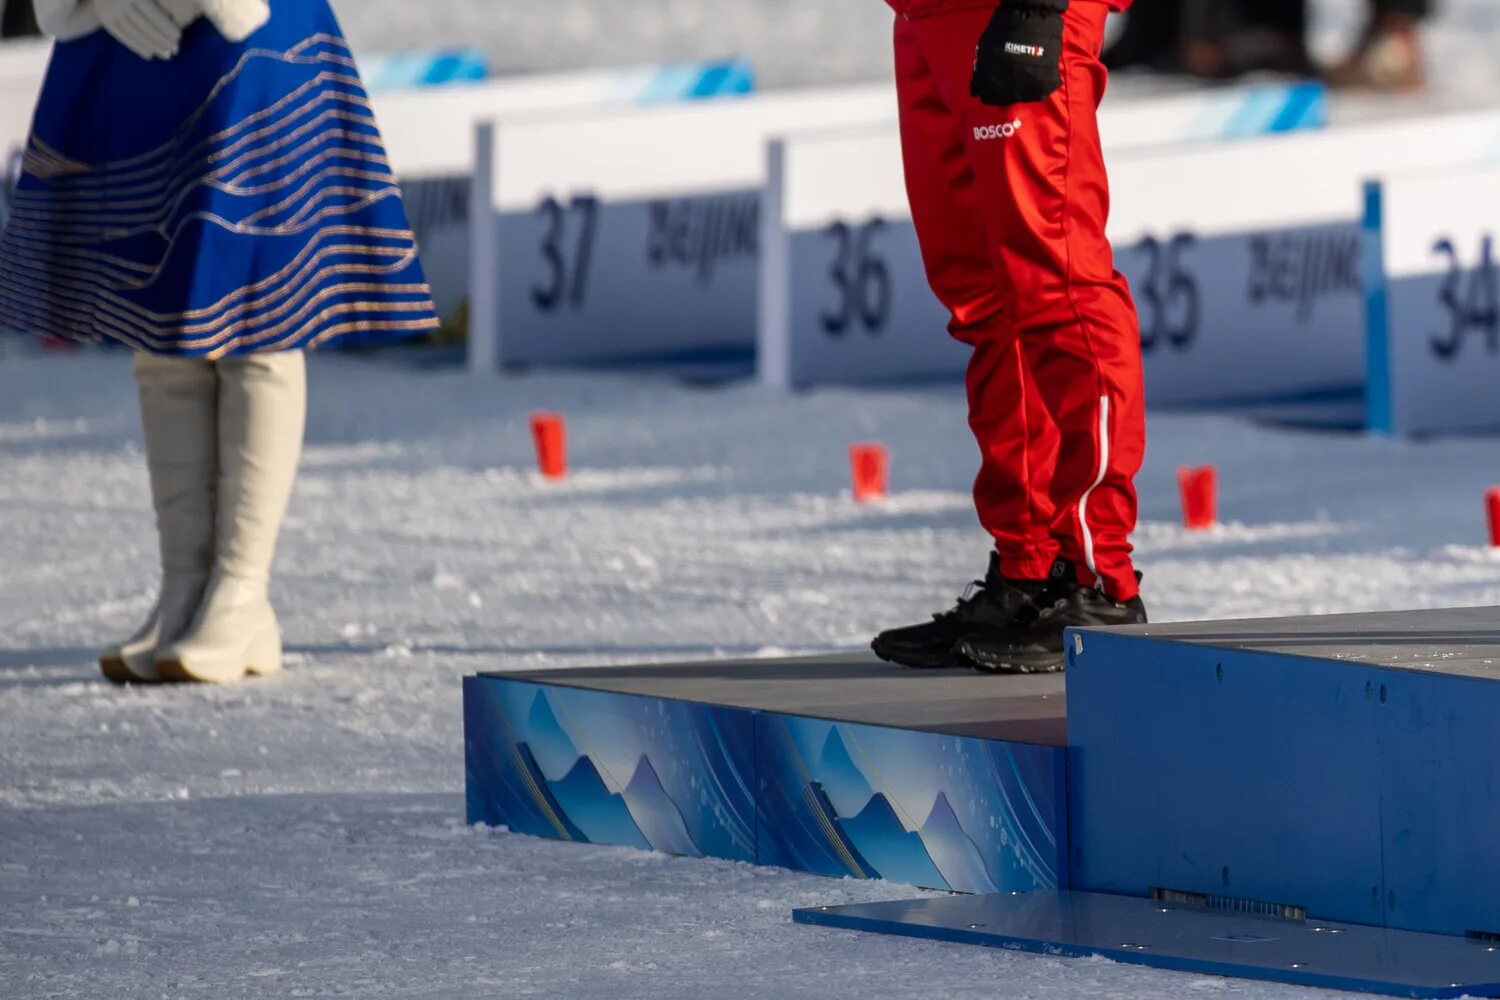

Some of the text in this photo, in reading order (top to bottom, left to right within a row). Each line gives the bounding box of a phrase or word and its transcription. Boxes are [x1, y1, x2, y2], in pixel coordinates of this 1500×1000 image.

[973, 121, 1016, 141] BOSCO
[531, 190, 598, 312] 37
[818, 215, 891, 339] 36
[1133, 232, 1203, 353] 35
